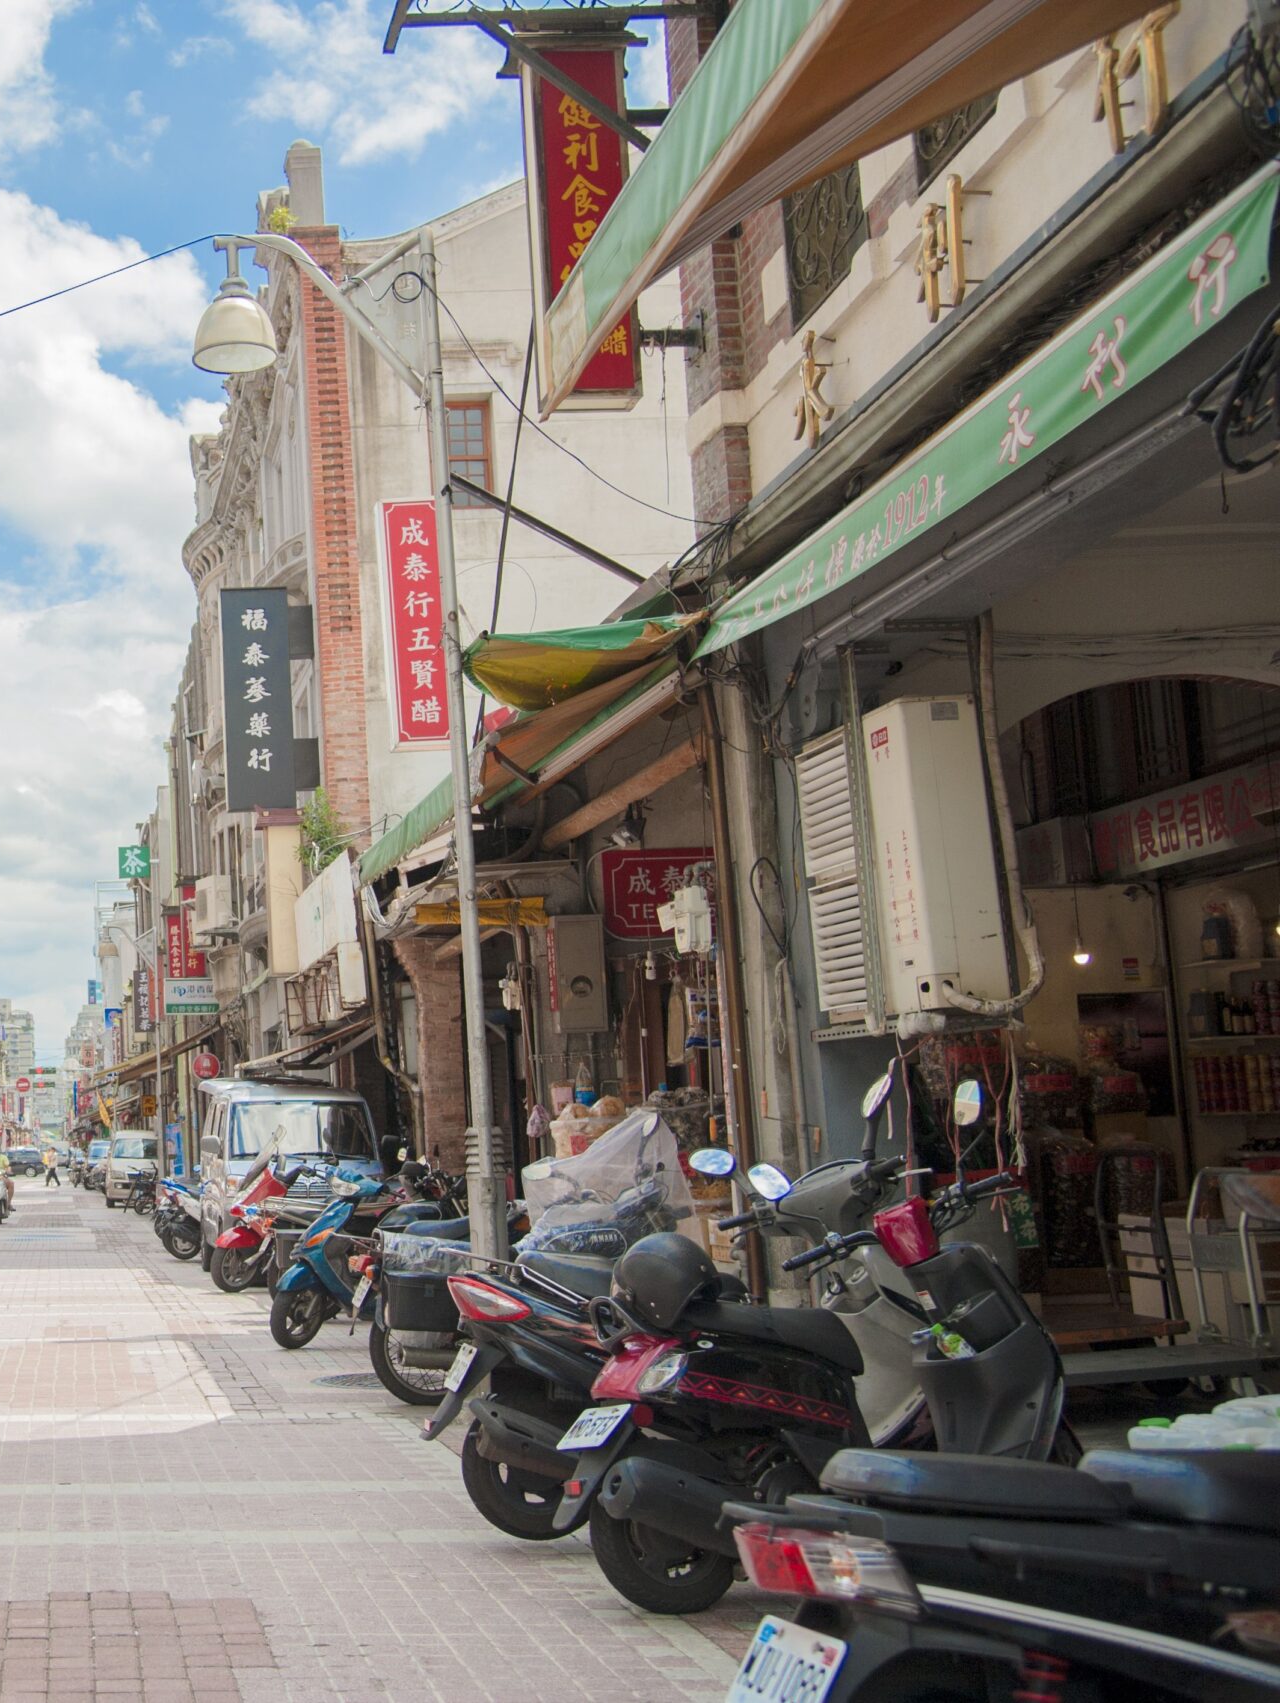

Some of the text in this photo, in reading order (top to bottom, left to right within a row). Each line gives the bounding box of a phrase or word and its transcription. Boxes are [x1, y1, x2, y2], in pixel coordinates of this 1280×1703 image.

[999, 233, 1237, 464] 永利行
[399, 518, 442, 725] 成泰行五賢醋
[122, 846, 148, 876] 茶
